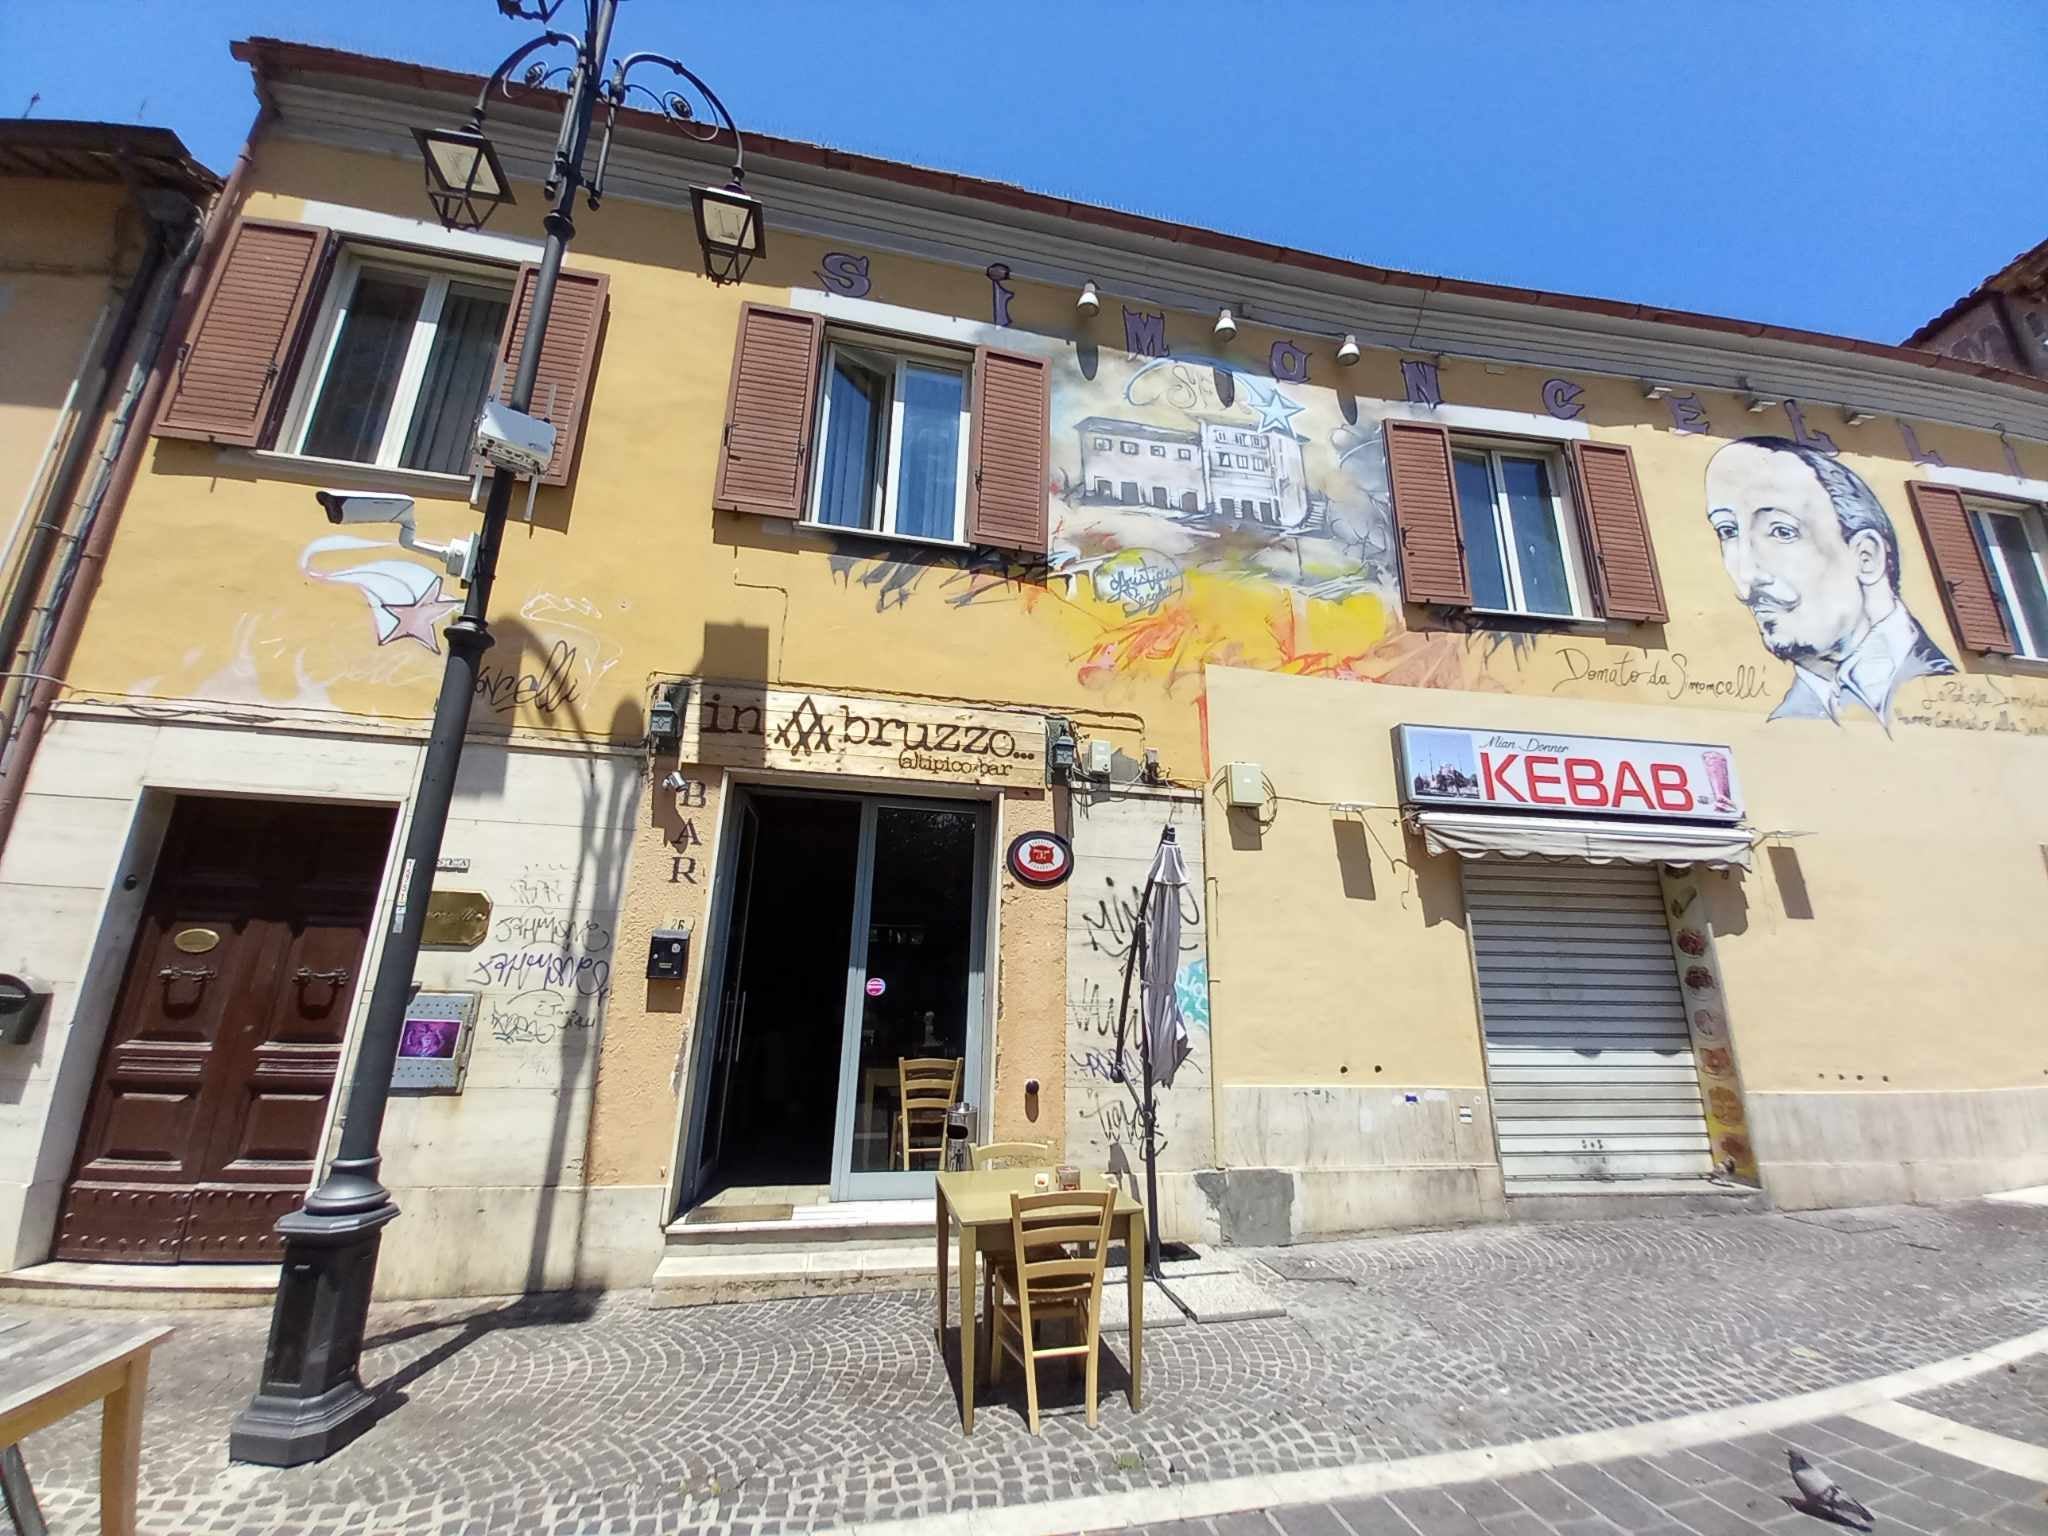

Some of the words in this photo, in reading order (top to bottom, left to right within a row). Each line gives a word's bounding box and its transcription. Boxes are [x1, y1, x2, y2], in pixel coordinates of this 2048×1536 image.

[1647, 661, 1669, 686] da
[701, 693, 762, 736] in
[1479, 752, 1694, 812] KEBAB
